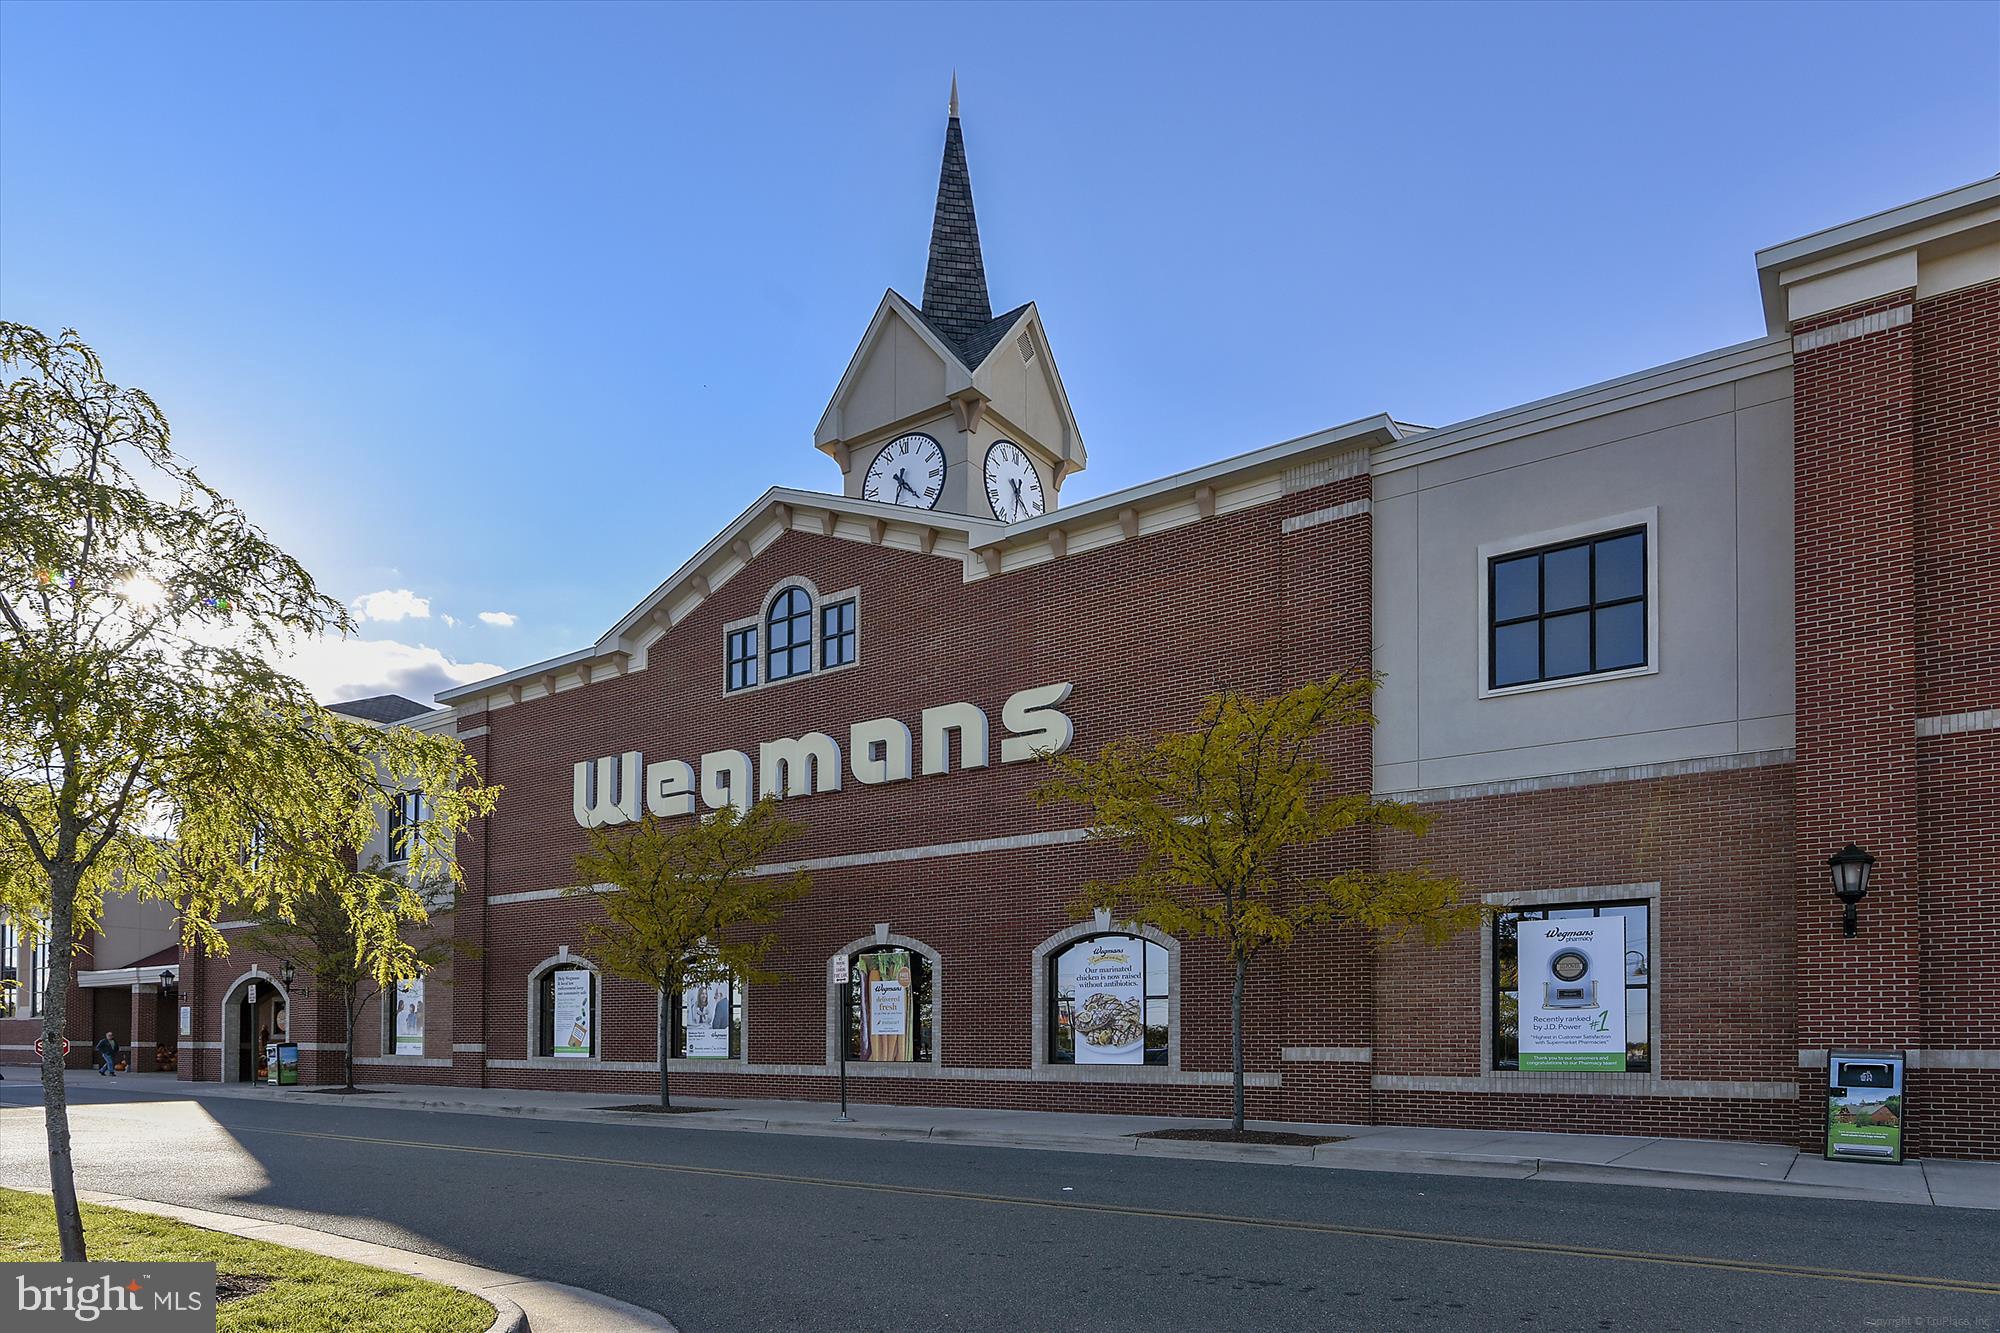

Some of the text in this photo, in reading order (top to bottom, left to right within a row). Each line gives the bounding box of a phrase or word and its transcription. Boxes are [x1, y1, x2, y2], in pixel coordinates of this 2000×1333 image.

[573, 682, 1074, 829] Wegmans
[1544, 926, 1594, 941] Wegmans
[1093, 945, 1124, 957] Wegmans
[1099, 965, 1132, 973] marinated
[874, 983, 902, 995] Wegmans
[1589, 1010, 1609, 1032] #1
